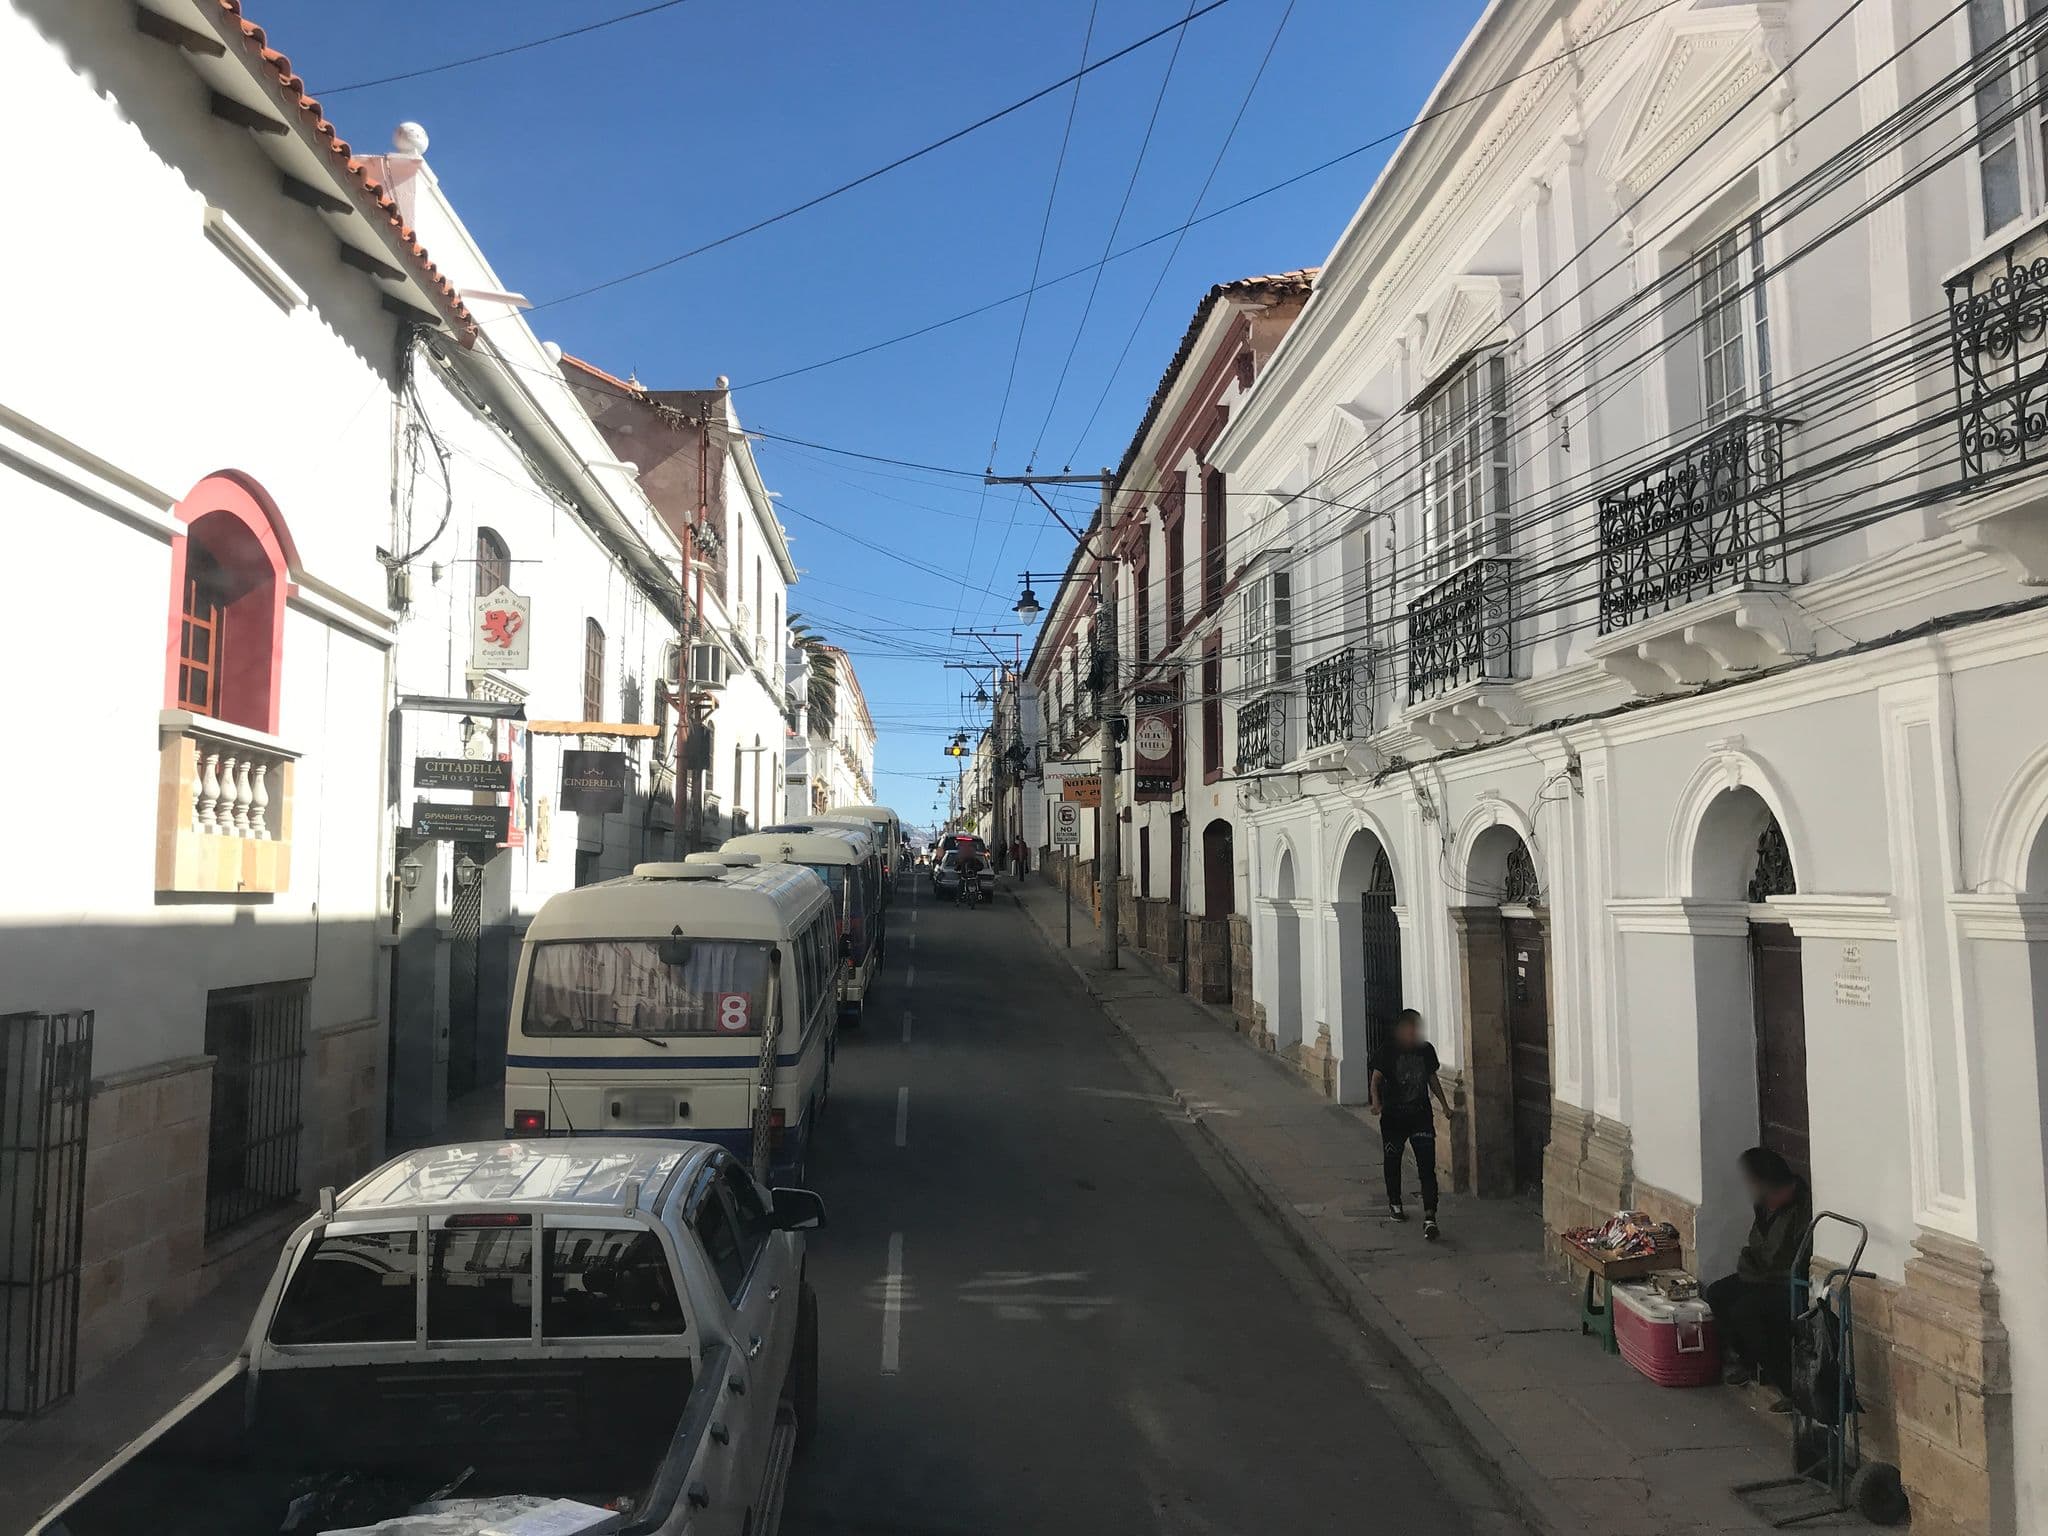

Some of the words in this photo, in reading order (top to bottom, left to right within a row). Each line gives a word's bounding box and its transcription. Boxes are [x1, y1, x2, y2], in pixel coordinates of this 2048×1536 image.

[425, 761, 502, 775] CITTADELLA
[441, 774, 486, 783] HOSTAL
[564, 777, 622, 788] CINDERELLA
[424, 812, 462, 821] SPANISH
[462, 813, 496, 822] SCHOOL
[721, 995, 747, 1030] 8
